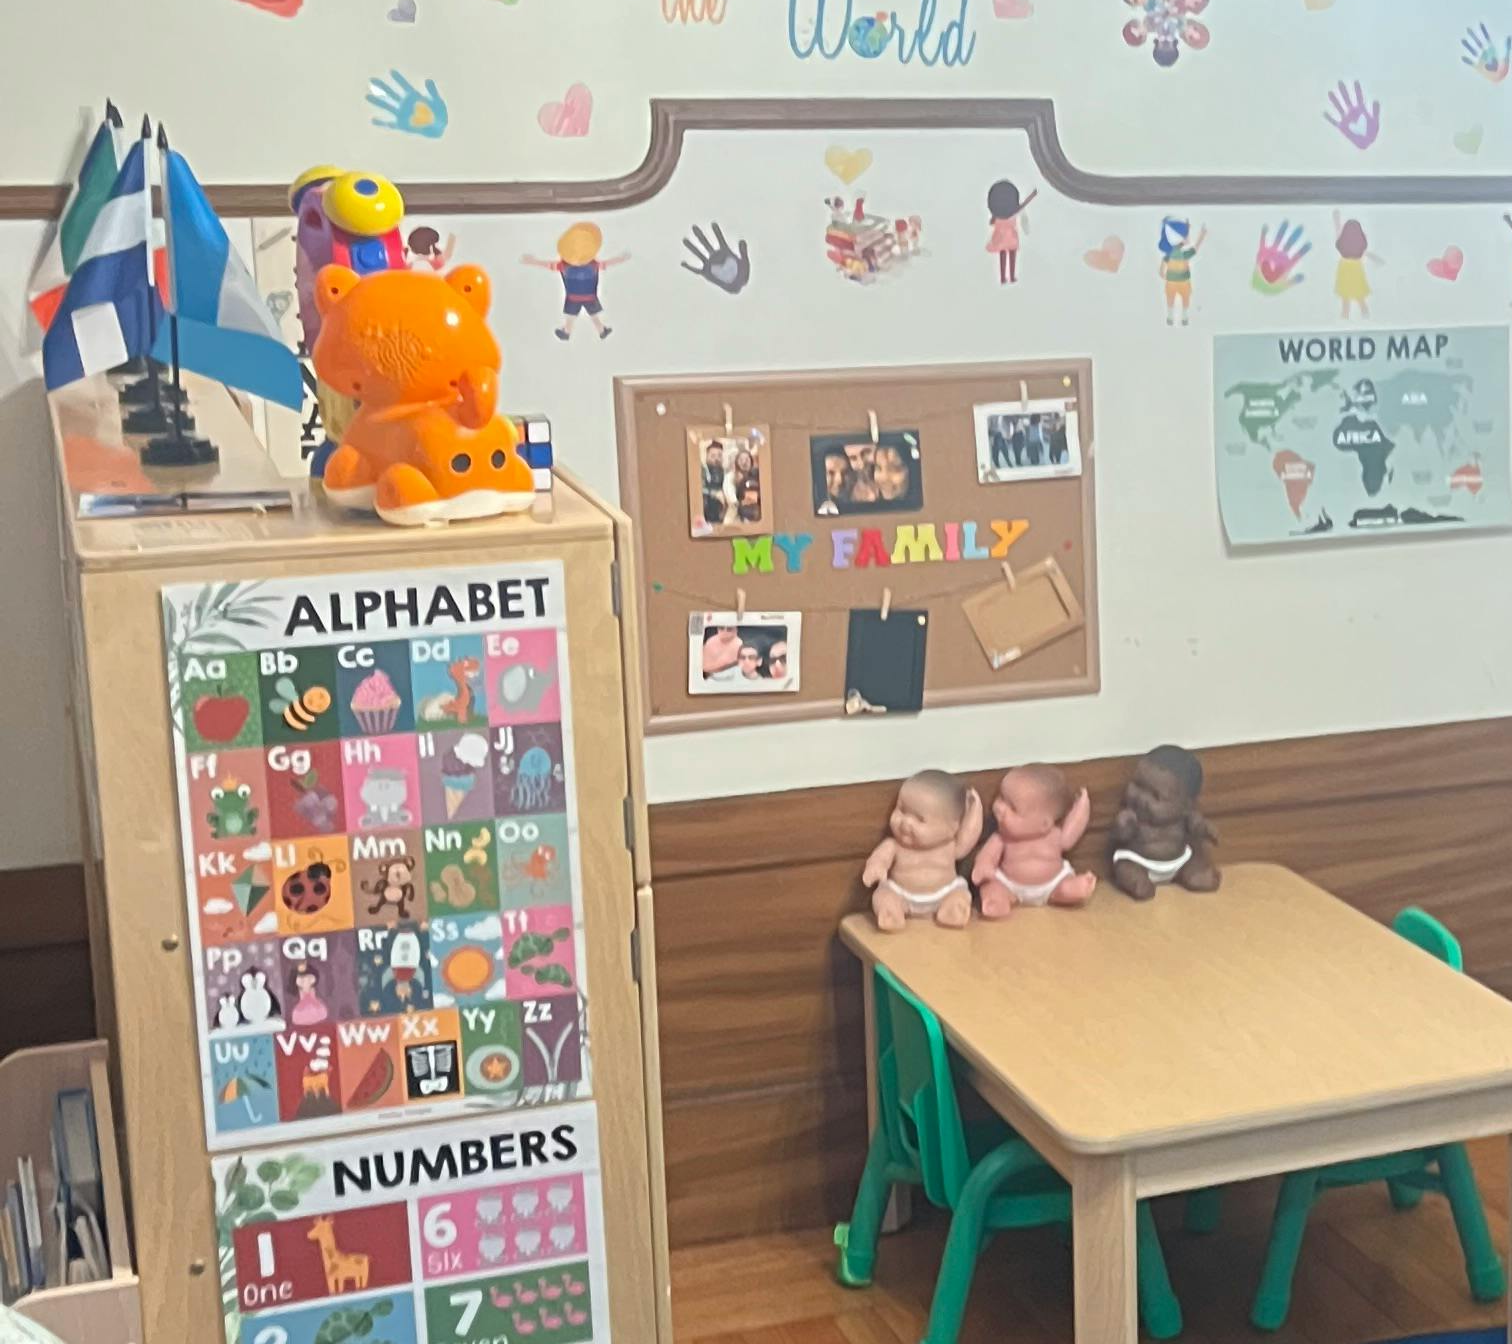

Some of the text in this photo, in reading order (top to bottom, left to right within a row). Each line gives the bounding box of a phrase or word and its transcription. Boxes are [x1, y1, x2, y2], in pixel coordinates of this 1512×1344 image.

[1278, 334, 1449, 363] WORLD MAP
[1336, 429, 1382, 444] AFRICA
[732, 520, 1030, 574] MY FAMILY
[284, 577, 550, 637] ALPHABET
[337, 645, 376, 669] Cc
[411, 637, 451, 663] Dd
[486, 634, 520, 657] Ee
[183, 656, 228, 682] Aa
[259, 651, 298, 676] Bb
[267, 745, 312, 775] Gg
[343, 738, 382, 765] Hh
[424, 828, 462, 854] Nn
[498, 823, 540, 844] Oo
[352, 835, 407, 861] Mm
[199, 851, 237, 878] Kk
[358, 928, 389, 953] Rr
[431, 918, 460, 943] Ss
[207, 947, 243, 974] Pp
[282, 936, 329, 962] Qq
[462, 1007, 497, 1034] Yy
[522, 999, 553, 1024] Zz
[338, 1022, 391, 1048] Ww
[401, 1014, 440, 1039] Xx
[214, 1041, 250, 1065] Uu
[275, 1032, 318, 1057] Vv
[333, 1123, 579, 1197] NUMBERS
[423, 1201, 458, 1248] 6
[256, 1231, 276, 1279] 1
[243, 1280, 294, 1307] One
[449, 1290, 484, 1338] 7
